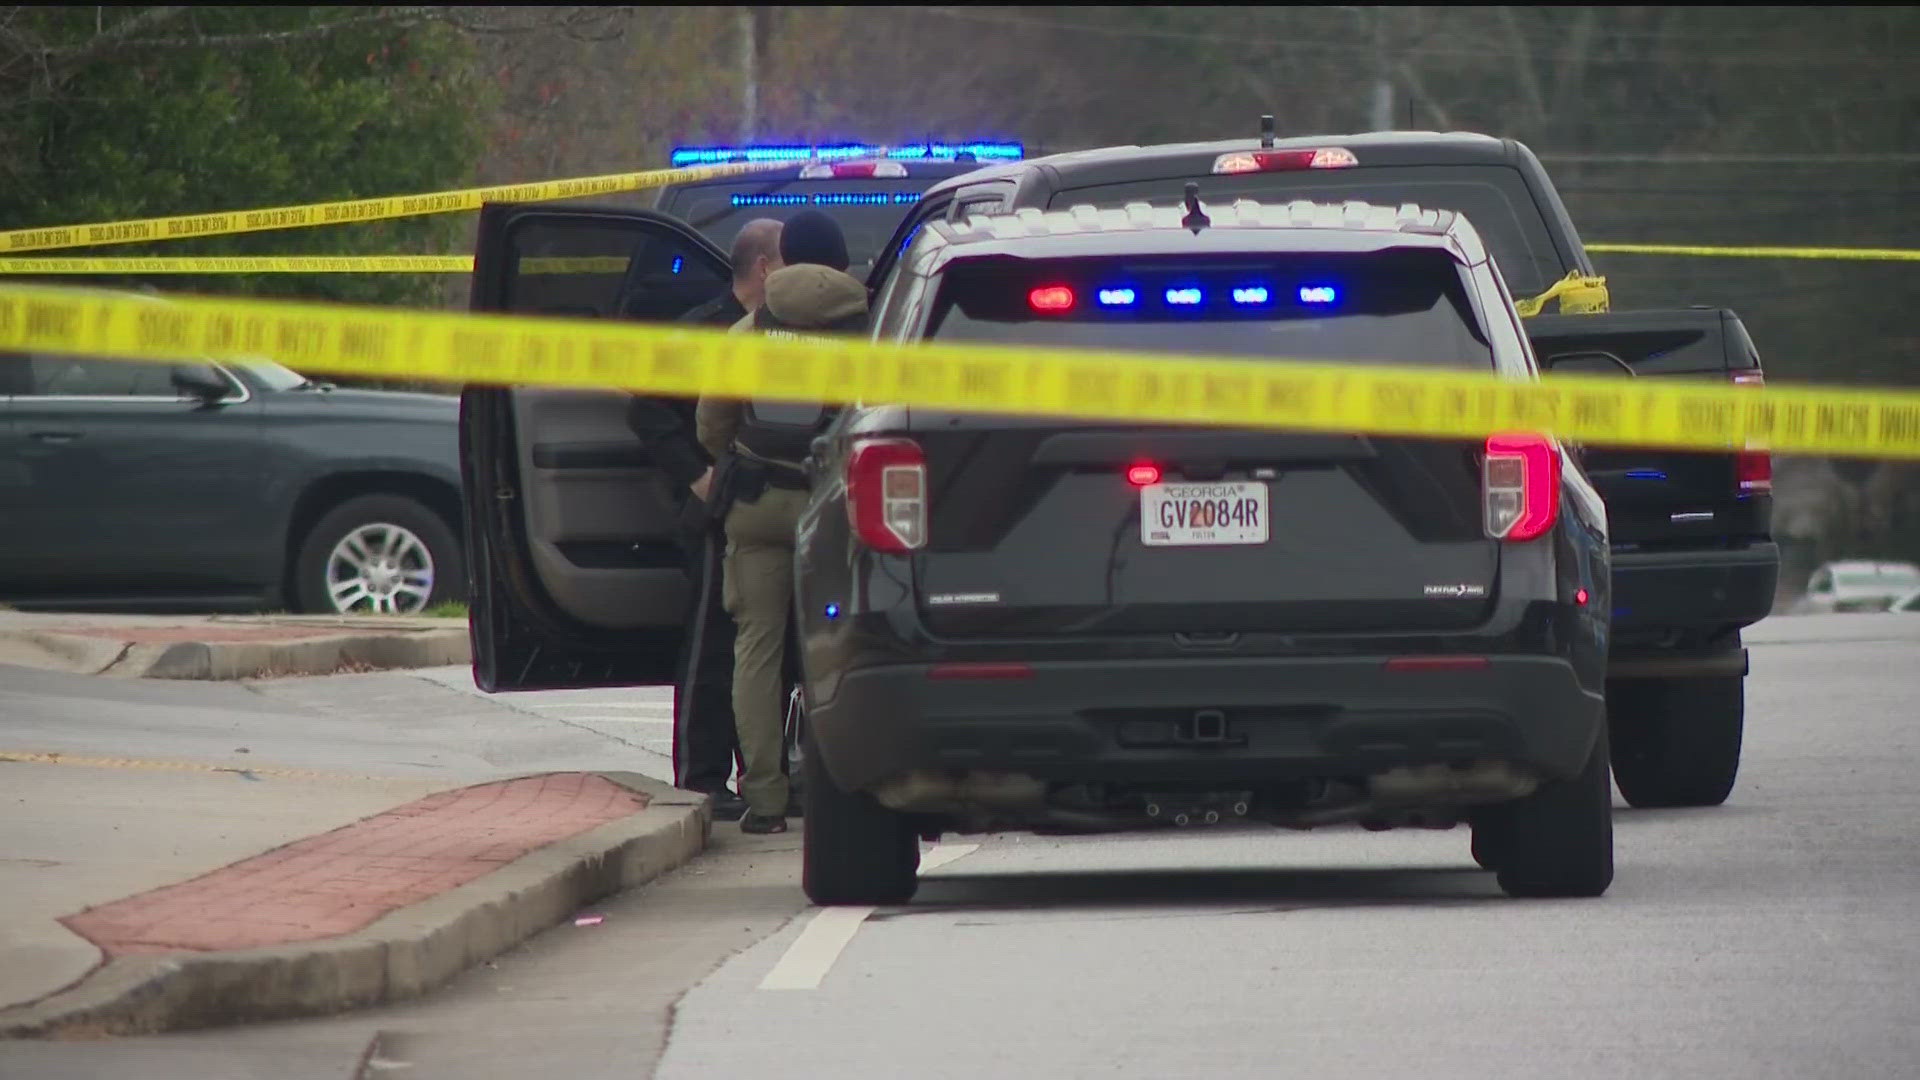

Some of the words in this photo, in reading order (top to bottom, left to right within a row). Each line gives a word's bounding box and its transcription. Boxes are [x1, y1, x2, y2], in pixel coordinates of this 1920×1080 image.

[133, 223, 149, 237] POLICE
[167, 220, 182, 234] CROSS
[183, 219, 193, 233] NOT
[193, 218, 200, 232] DO
[200, 217, 209, 231] LINE
[211, 216, 227, 230] POLICE
[43, 231, 51, 245] LINE
[54, 229, 70, 244] POLICE
[89, 227, 104, 241] CROSS
[104, 226, 114, 240] NOT
[114, 225, 122, 239] DO
[122, 224, 132, 238] LINE
[9, 233, 25, 248] CROSS
[25, 232, 36, 246] NOT
[36, 232, 43, 246] DO
[1169, 486, 1237, 498] GEORGIA
[1160, 498, 1259, 529] GV2084R
